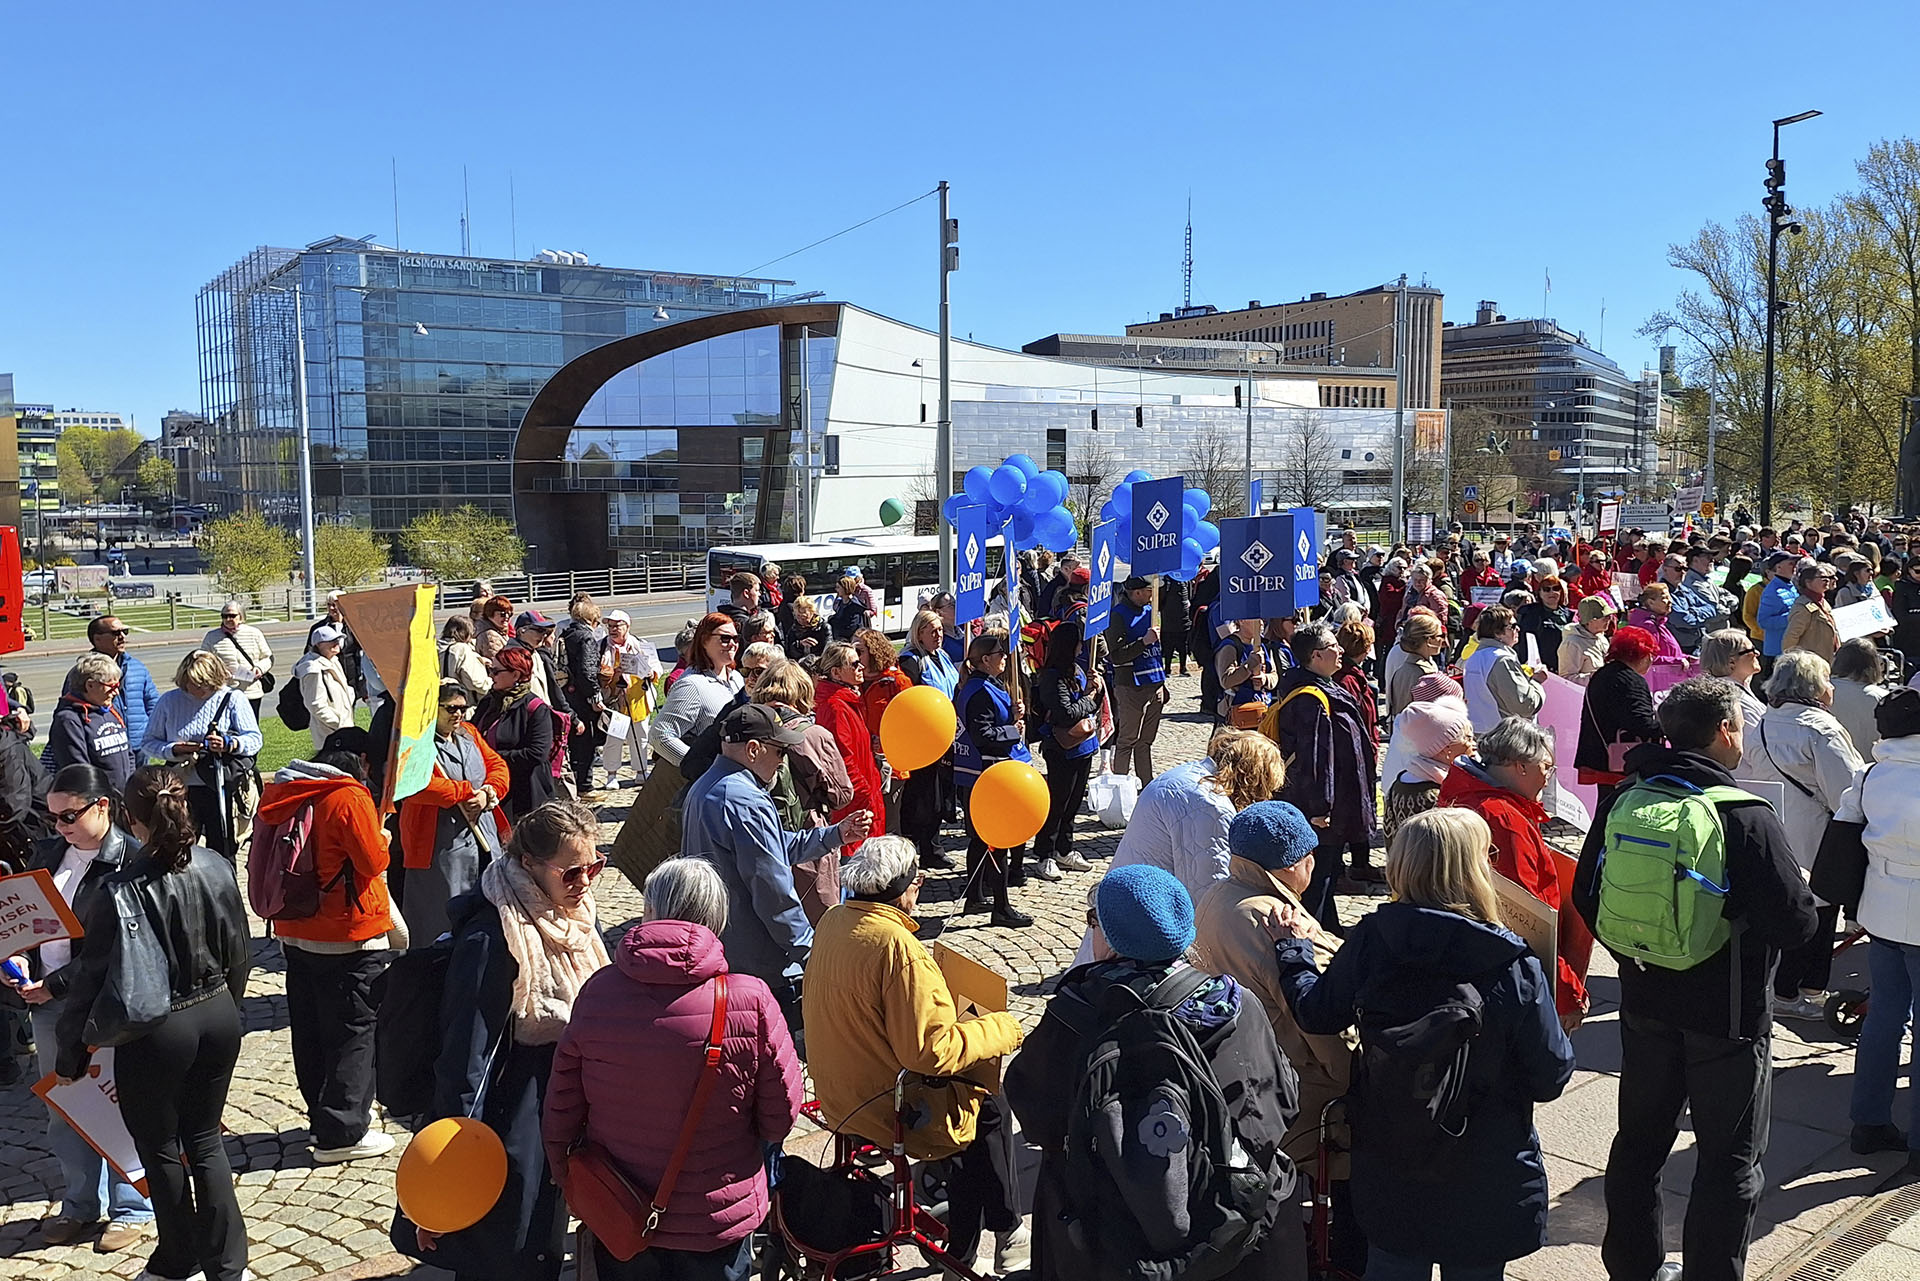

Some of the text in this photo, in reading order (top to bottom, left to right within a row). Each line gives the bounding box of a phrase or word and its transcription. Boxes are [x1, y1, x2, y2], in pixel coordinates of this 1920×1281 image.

[398, 256, 491, 272] HELSINGIN SANOMAT
[25, 408, 47, 417] KPMG
